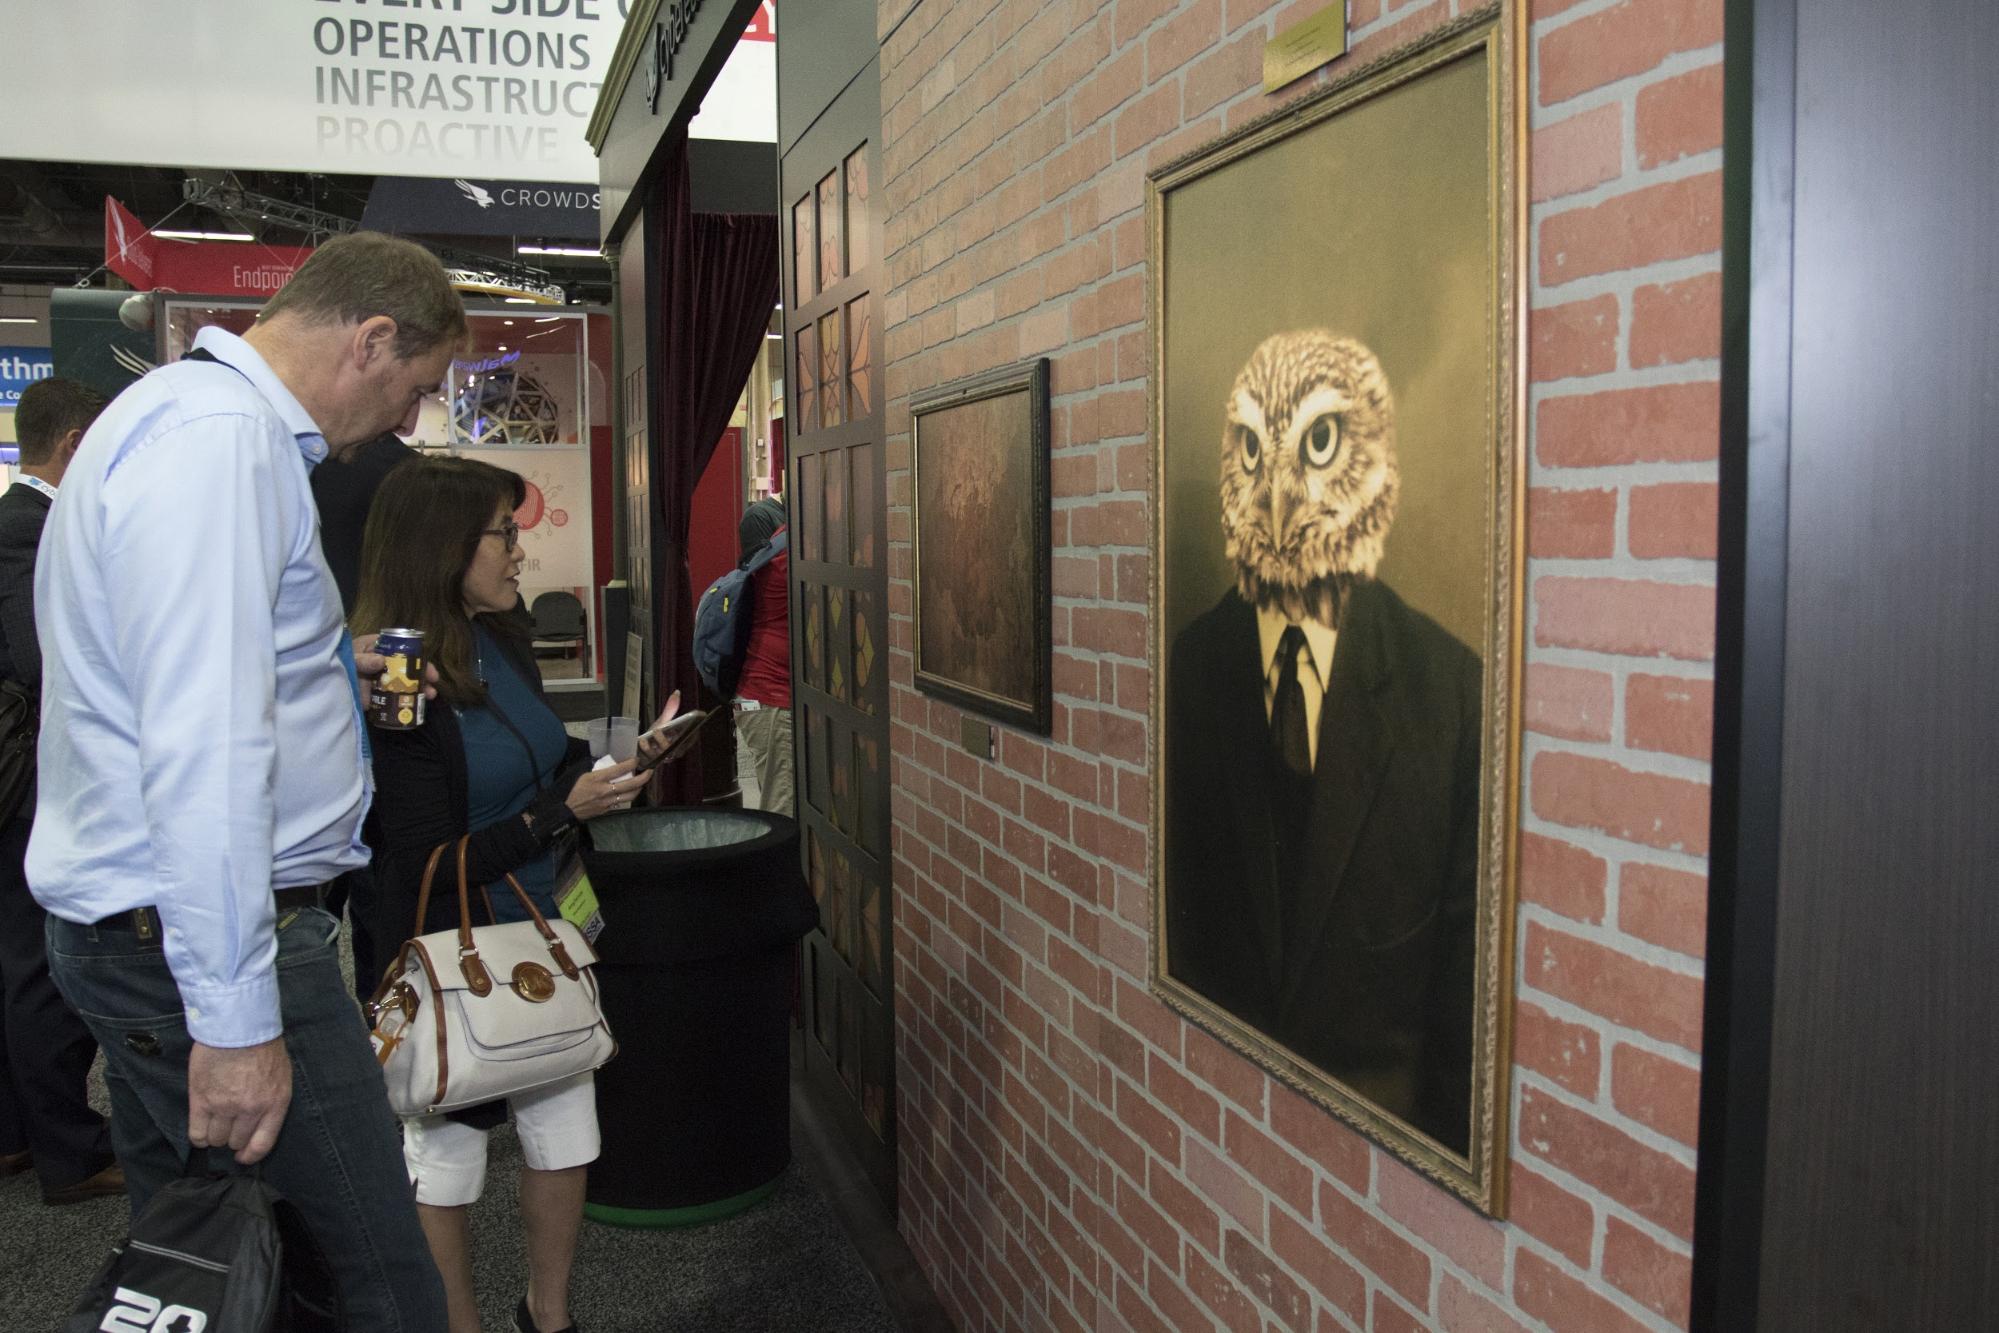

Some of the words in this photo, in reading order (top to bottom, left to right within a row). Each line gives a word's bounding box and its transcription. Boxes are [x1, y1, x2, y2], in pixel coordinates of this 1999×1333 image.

[313, 16, 590, 70] OPERATIONS
[316, 115, 558, 161] PROACTIVE
[501, 188, 600, 210] CROWDS
